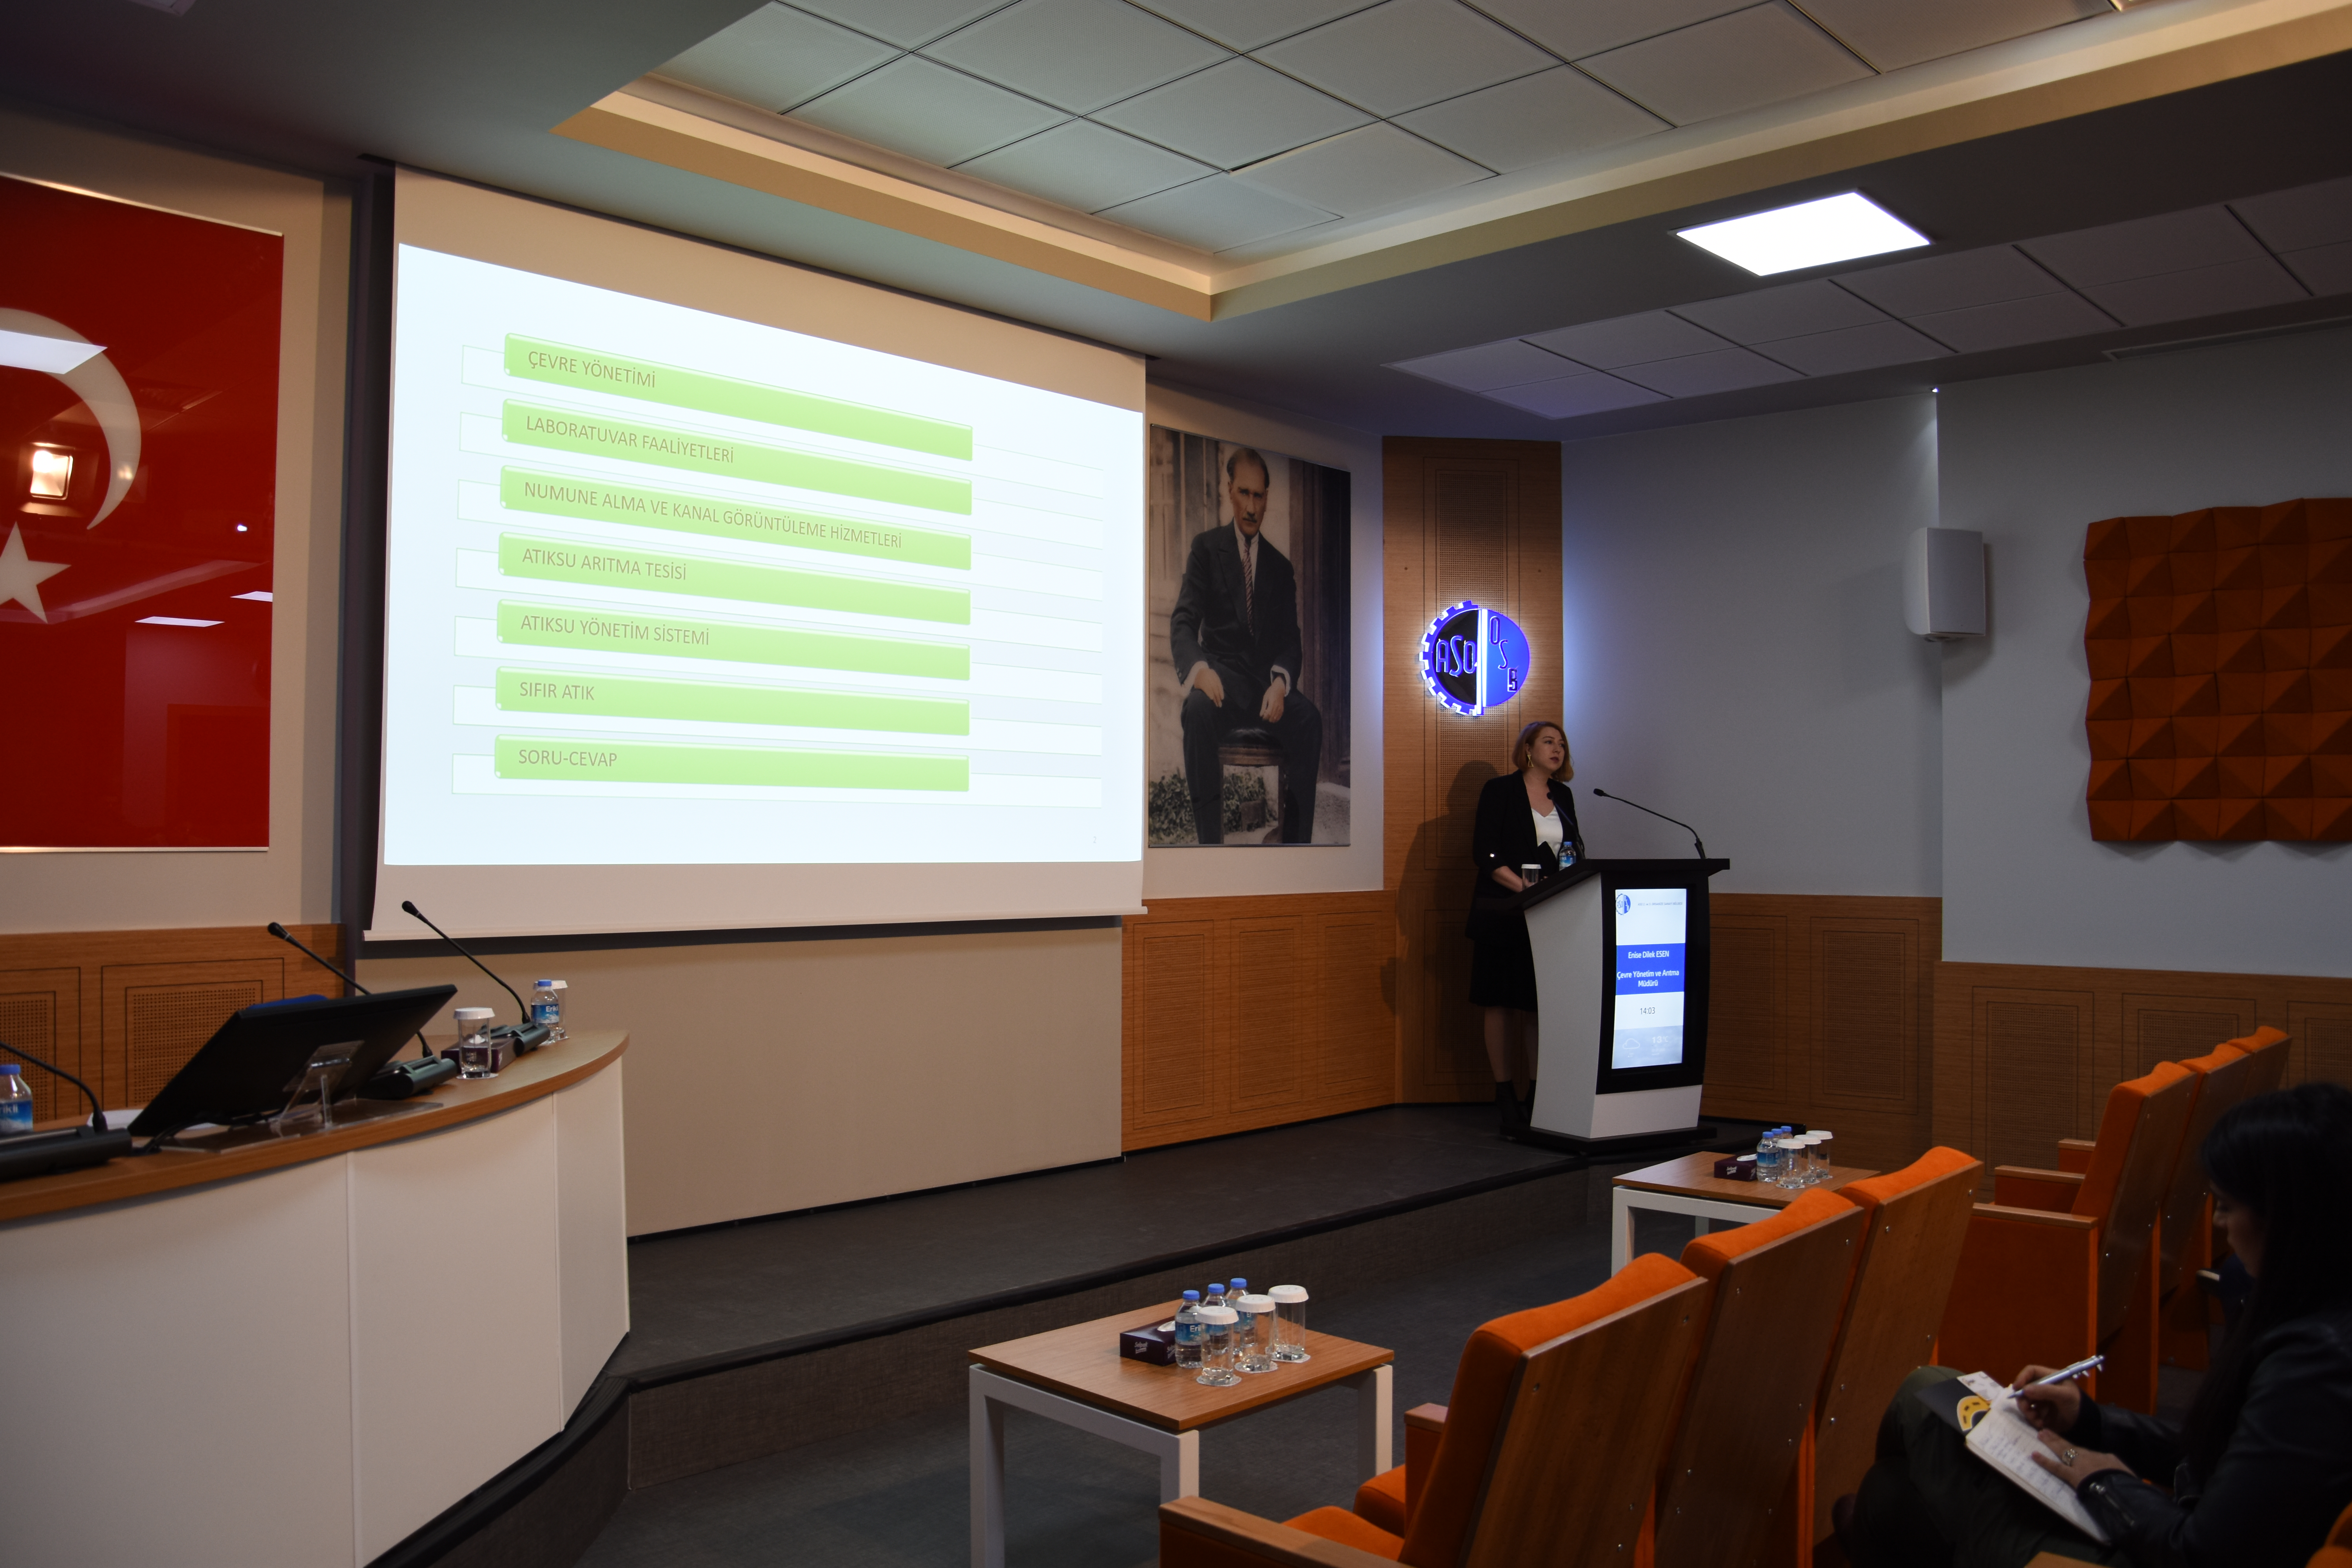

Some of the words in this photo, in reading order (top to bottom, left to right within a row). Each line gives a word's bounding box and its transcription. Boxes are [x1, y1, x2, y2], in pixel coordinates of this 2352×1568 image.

[528, 351, 577, 373] ÇEVRE
[582, 359, 655, 388] YÖNETİMİ
[527, 416, 637, 447] LABORATUVAR
[642, 435, 733, 463] FAALİYETLERİ
[525, 482, 597, 506] NUMUNE
[602, 493, 646, 513] ALMA
[650, 500, 668, 515] VE
[673, 503, 719, 523] KANAL
[723, 508, 826, 538] GÖRÜNTÜLEME
[831, 526, 901, 548] HİZMETLERİ
[522, 548, 576, 568] ATIKSU
[581, 555, 641, 575] ARITMA
[645, 562, 686, 580] TESİSİ
[521, 615, 574, 633] ATIKSU
[580, 617, 649, 640] YÖNETİM
[654, 624, 709, 645] SİSTEMİ
[1436, 635, 1477, 677] ASO
[520, 682, 557, 698] SIFIR
[562, 684, 594, 701] ATIK
[519, 749, 617, 767] SORU-CEVAP
[1617, 971, 1632, 980] Çevre
